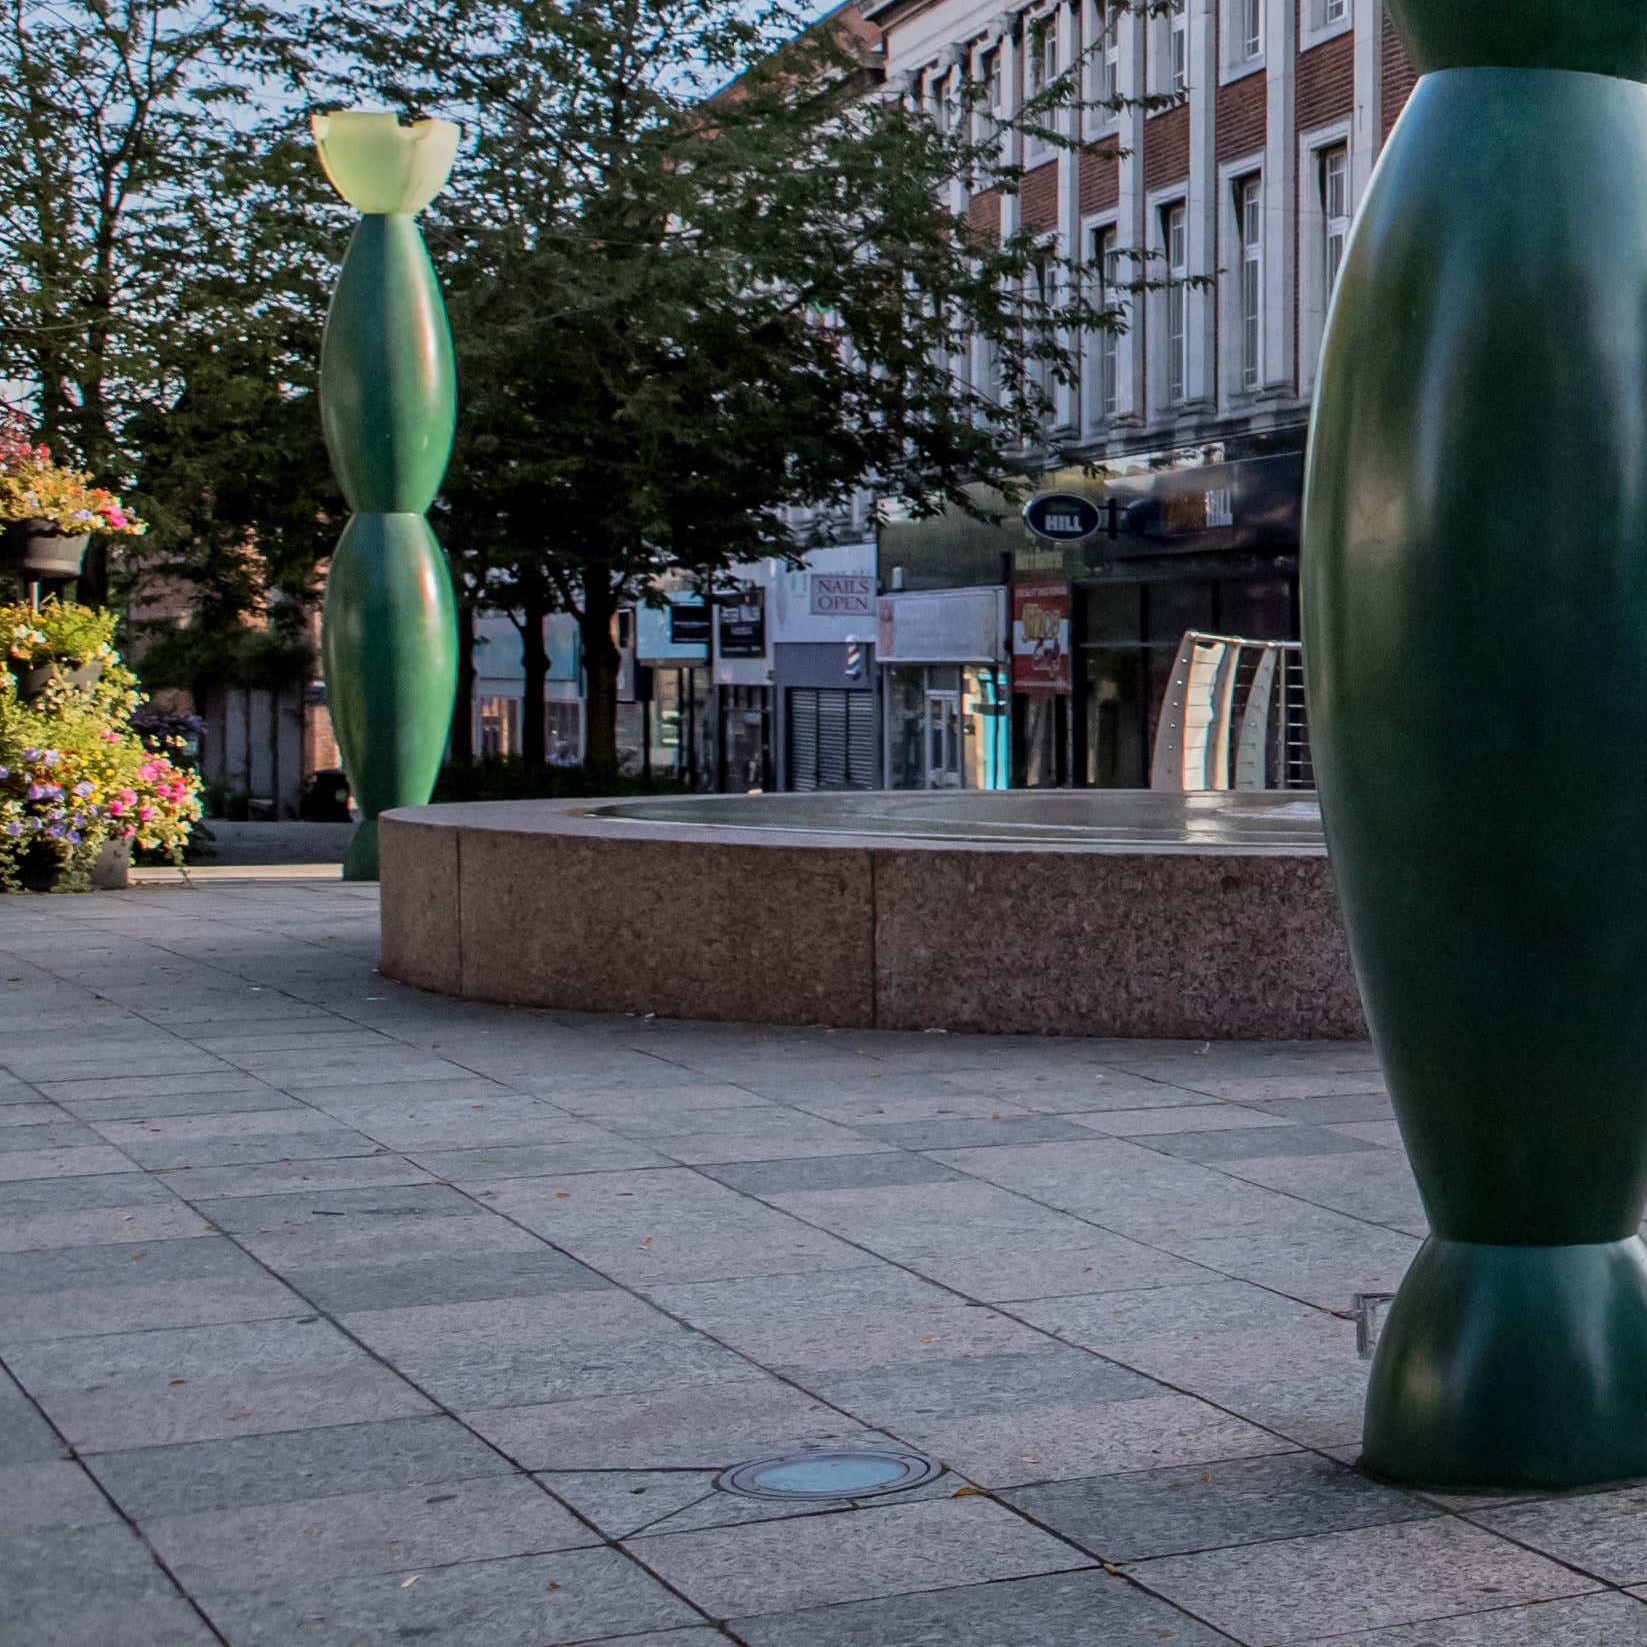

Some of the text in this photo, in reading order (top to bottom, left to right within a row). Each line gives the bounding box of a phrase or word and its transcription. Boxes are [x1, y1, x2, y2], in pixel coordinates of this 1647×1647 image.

[1045, 514, 1083, 532] HILL
[818, 579, 870, 594] NAILS
[818, 595, 868, 610] OPEN
